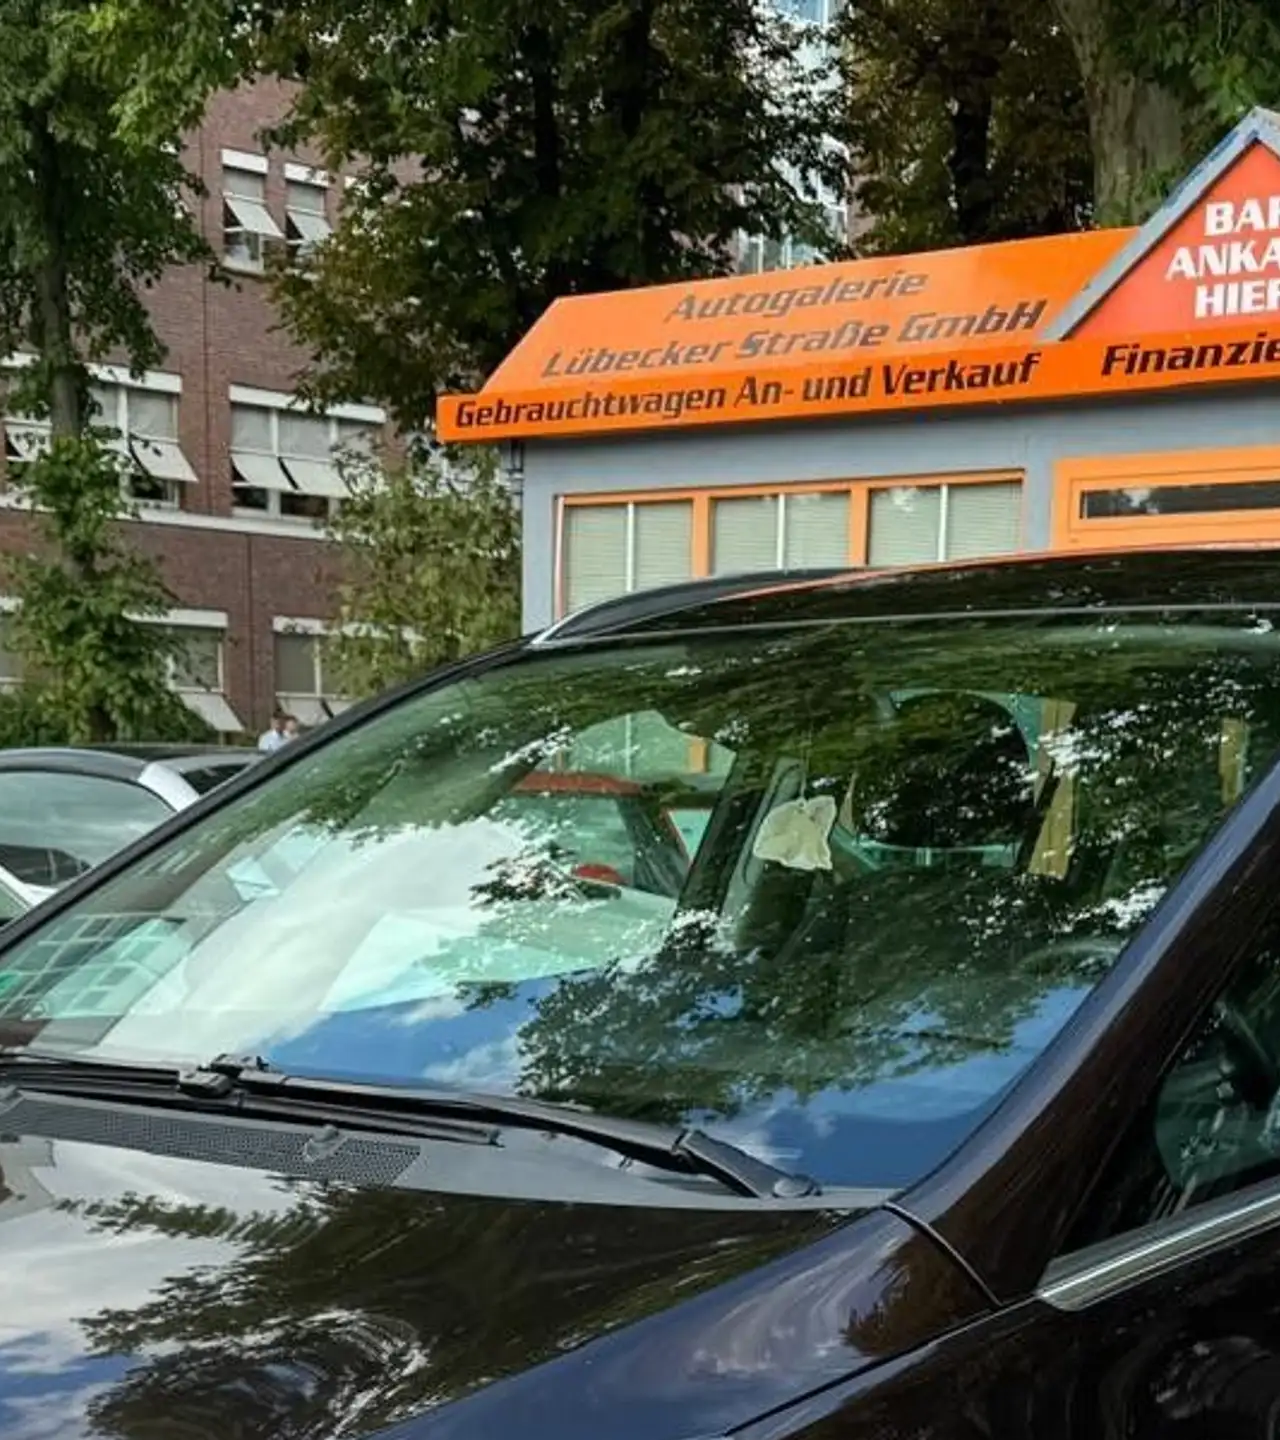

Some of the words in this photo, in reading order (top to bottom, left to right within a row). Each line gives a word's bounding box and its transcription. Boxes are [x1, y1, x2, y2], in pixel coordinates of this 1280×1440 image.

[663, 270, 930, 323] Autogalerie
[540, 339, 733, 378] Lübecker
[734, 318, 891, 359] Straße
[896, 298, 1048, 343] GmbH
[454, 386, 727, 429] Gebrauchtwagen
[733, 375, 795, 408] An-
[802, 366, 873, 401] und
[882, 352, 1041, 396] Verkauf
